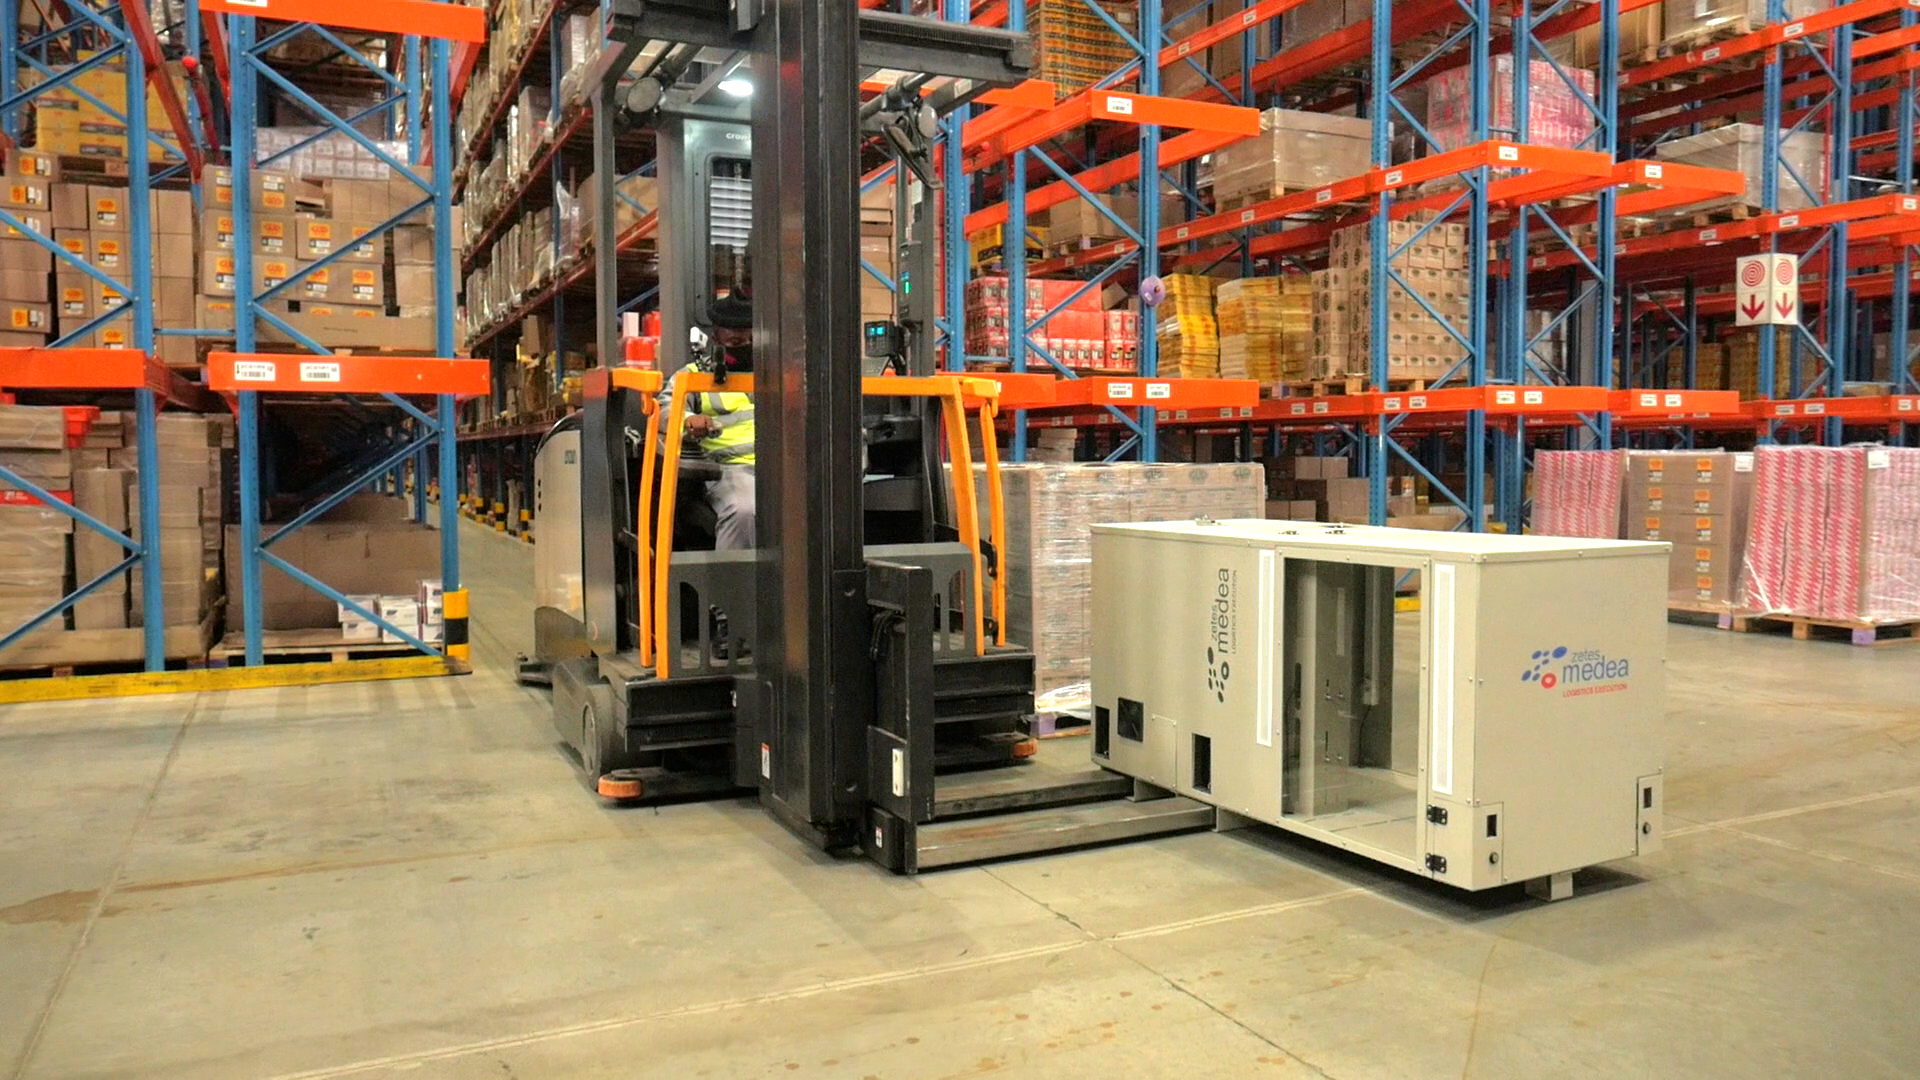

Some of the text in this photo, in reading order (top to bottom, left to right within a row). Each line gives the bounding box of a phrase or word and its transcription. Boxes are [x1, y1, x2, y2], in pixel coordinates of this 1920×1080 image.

[1215, 567, 1229, 654] medea
[1571, 650, 1601, 662] zetes
[1563, 655, 1629, 683] medea
[1563, 687, 1593, 697] LOGISTICS
